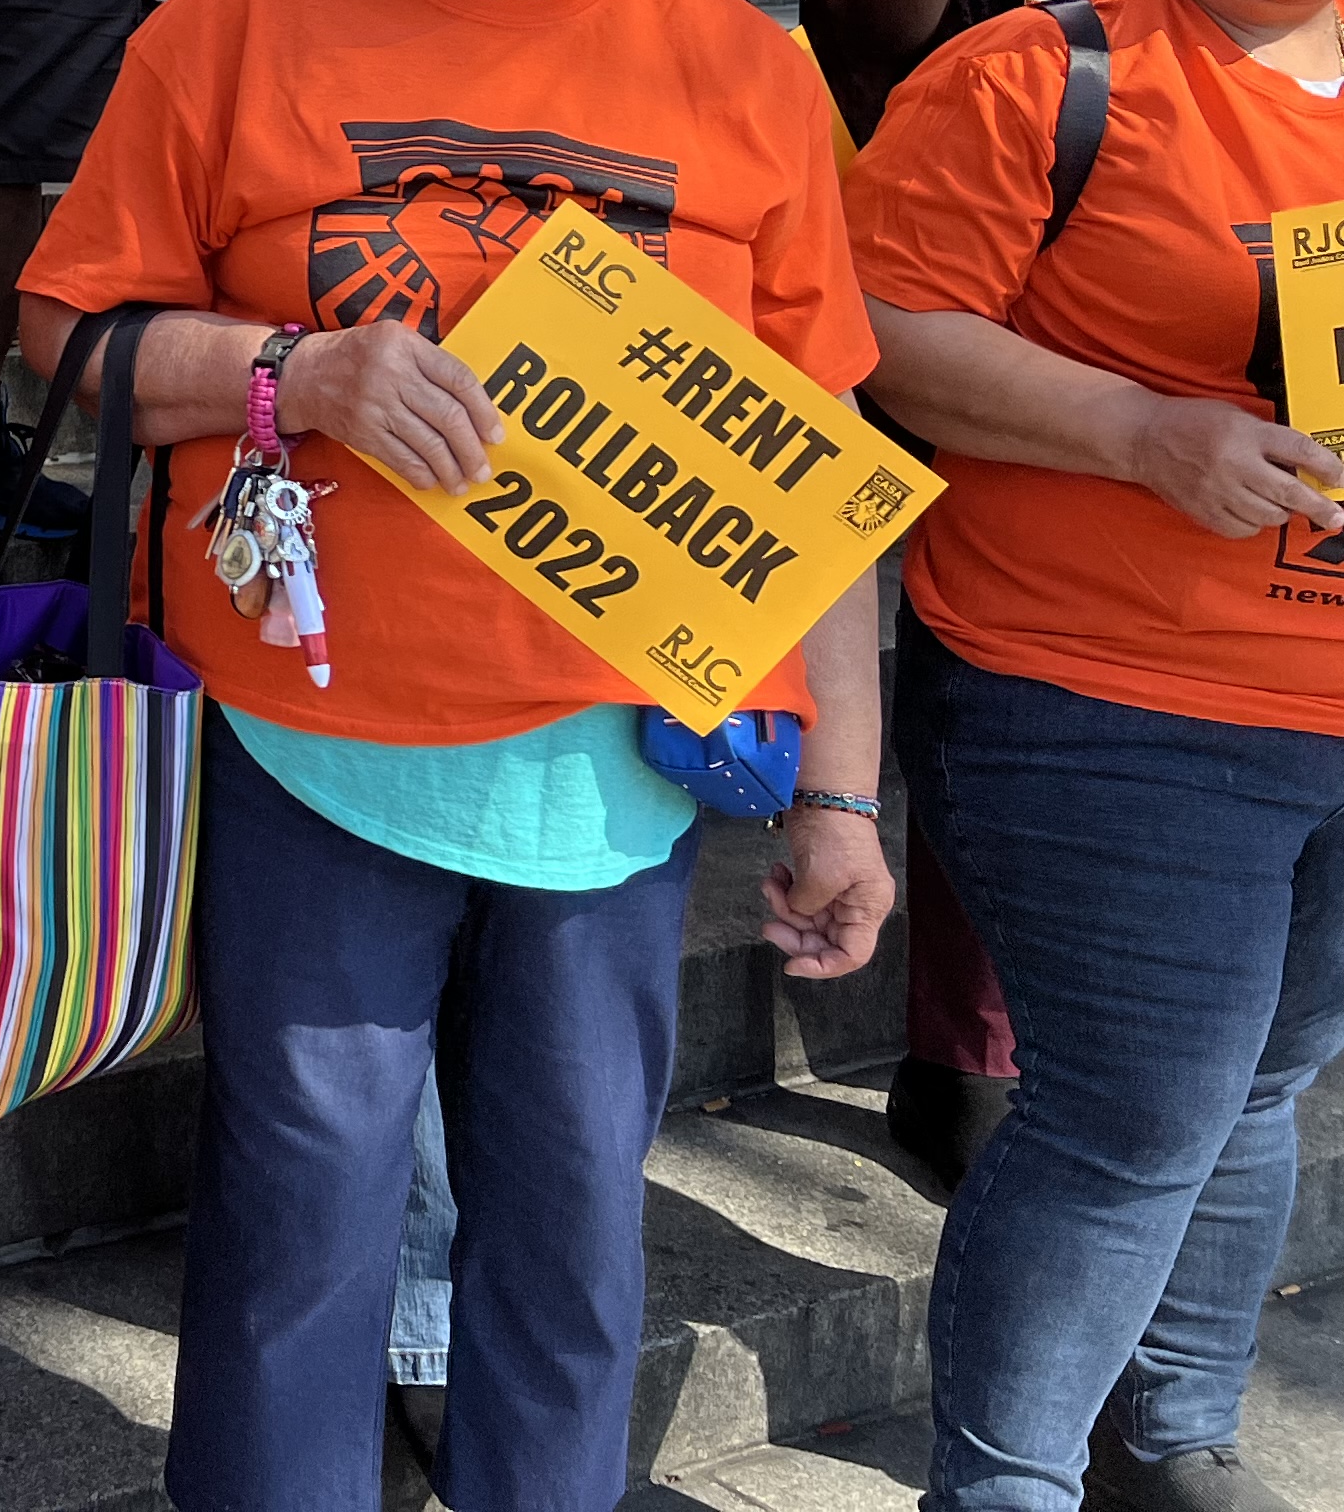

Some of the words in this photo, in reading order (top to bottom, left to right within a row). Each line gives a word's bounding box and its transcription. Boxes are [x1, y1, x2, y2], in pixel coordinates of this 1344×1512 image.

[553, 229, 636, 299] RJC
[616, 325, 844, 493] #RENT
[482, 341, 800, 606] ROLLBACK
[873, 473, 903, 501] CASA
[464, 468, 640, 620] 2022
[659, 623, 743, 693] RJC
